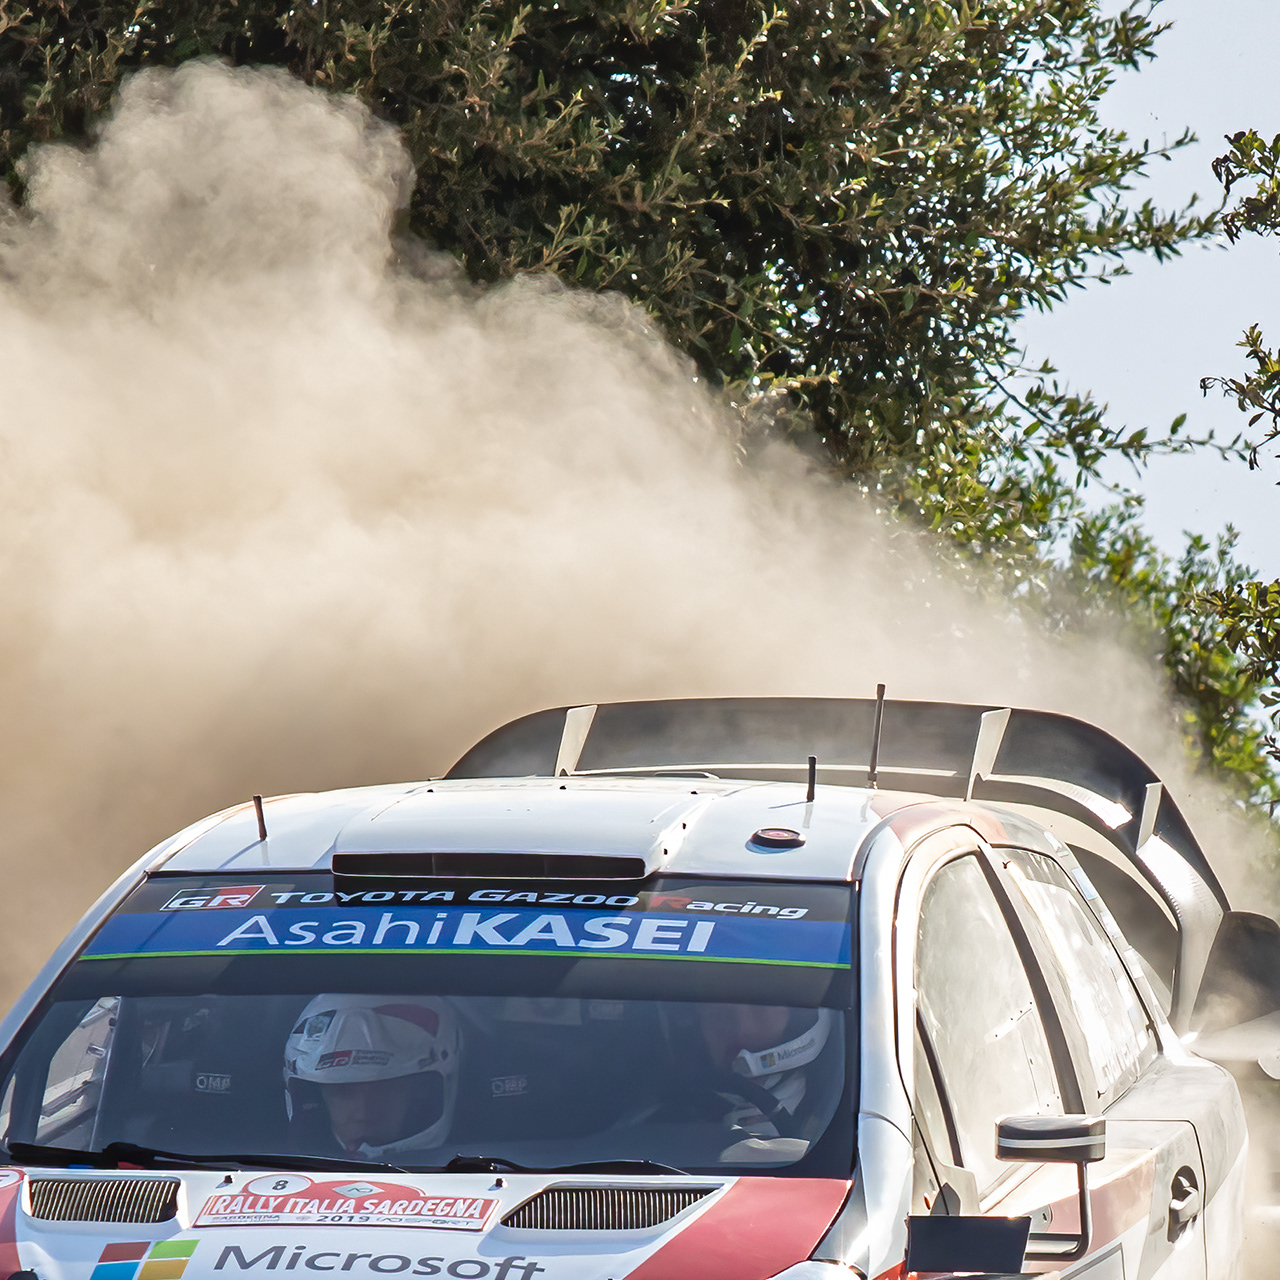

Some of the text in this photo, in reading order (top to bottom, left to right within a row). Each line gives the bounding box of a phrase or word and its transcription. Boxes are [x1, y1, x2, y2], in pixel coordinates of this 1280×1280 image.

[168, 889, 809, 919] GR TOYOTA GAZOO Racing
[216, 912, 716, 952] AsahiKASEI
[272, 1179, 289, 1191] 8
[210, 1196, 485, 1218] RALLY ITALIA SARDEGNA
